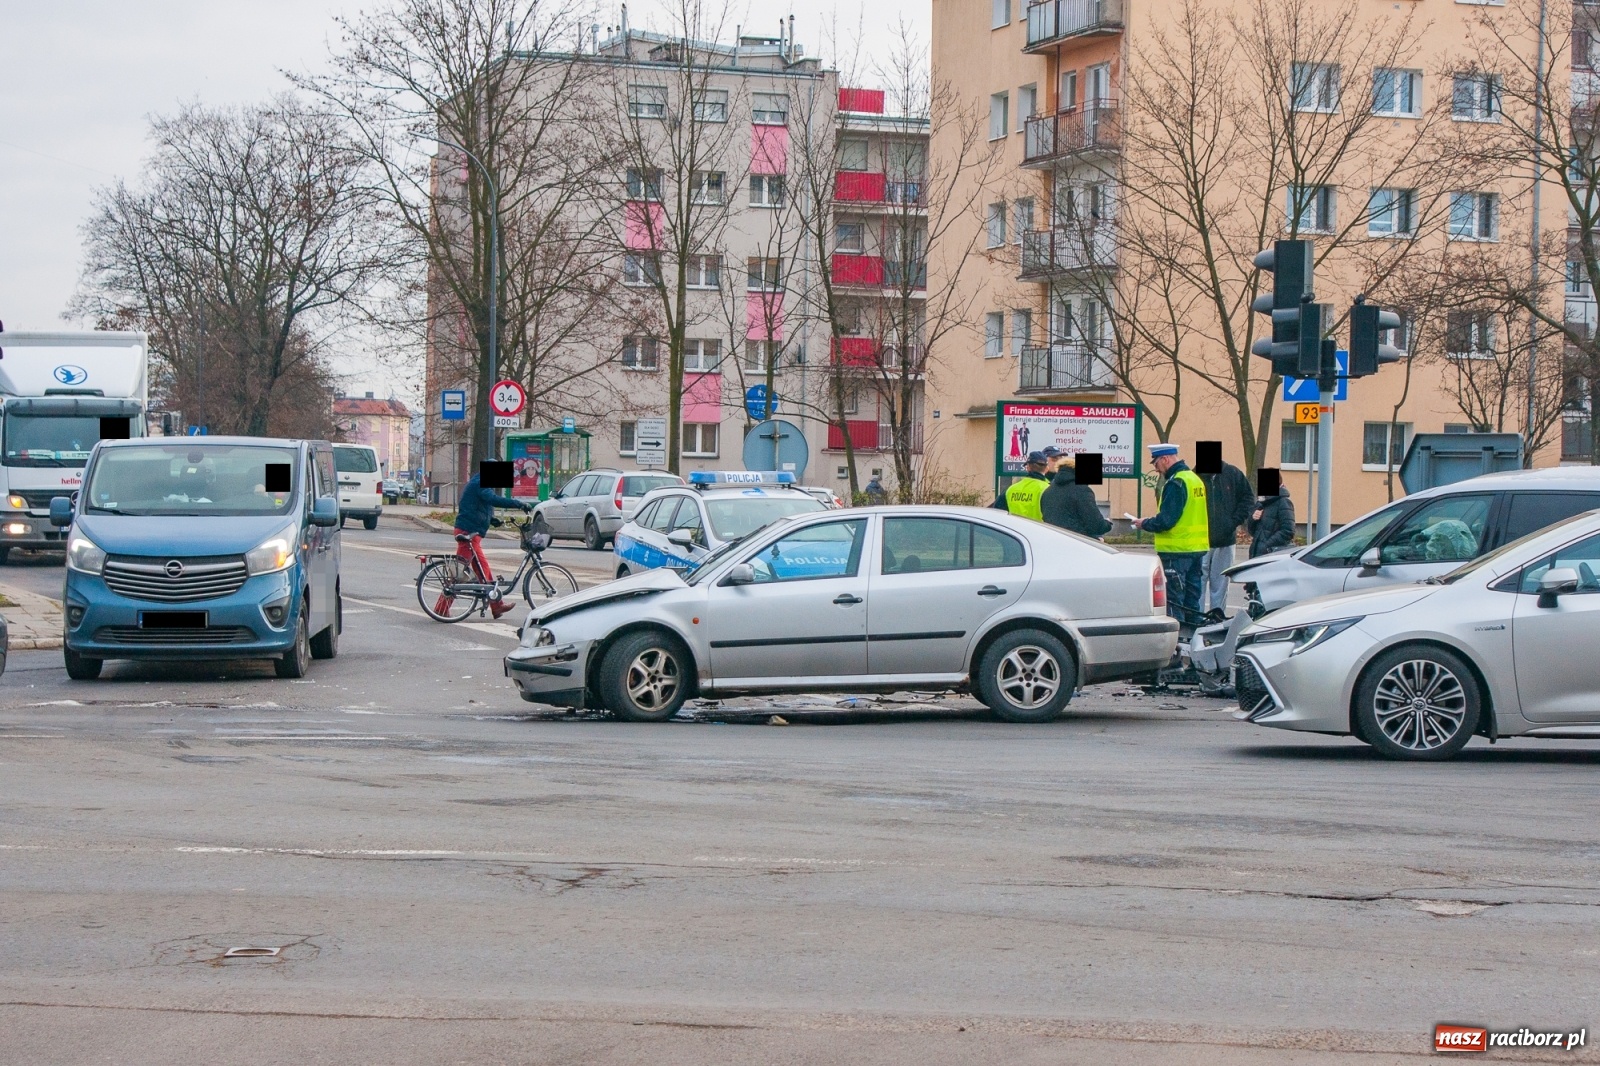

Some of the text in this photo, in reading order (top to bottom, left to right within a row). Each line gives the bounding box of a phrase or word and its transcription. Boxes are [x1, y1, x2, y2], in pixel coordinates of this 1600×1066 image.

[1009, 406, 1129, 418] Firma odzieżowa SAMURAJ
[1302, 406, 1319, 420] 93
[496, 418, 511, 426] 600
[1059, 417, 1086, 425] polskich
[1054, 427, 1087, 435] damskie
[1055, 437, 1083, 445] męskie
[1007, 463, 1018, 471] ul.
[1102, 465, 1130, 473] cibórz
[726, 473, 762, 483] POLICJA
[784, 556, 848, 566] POLICJA
